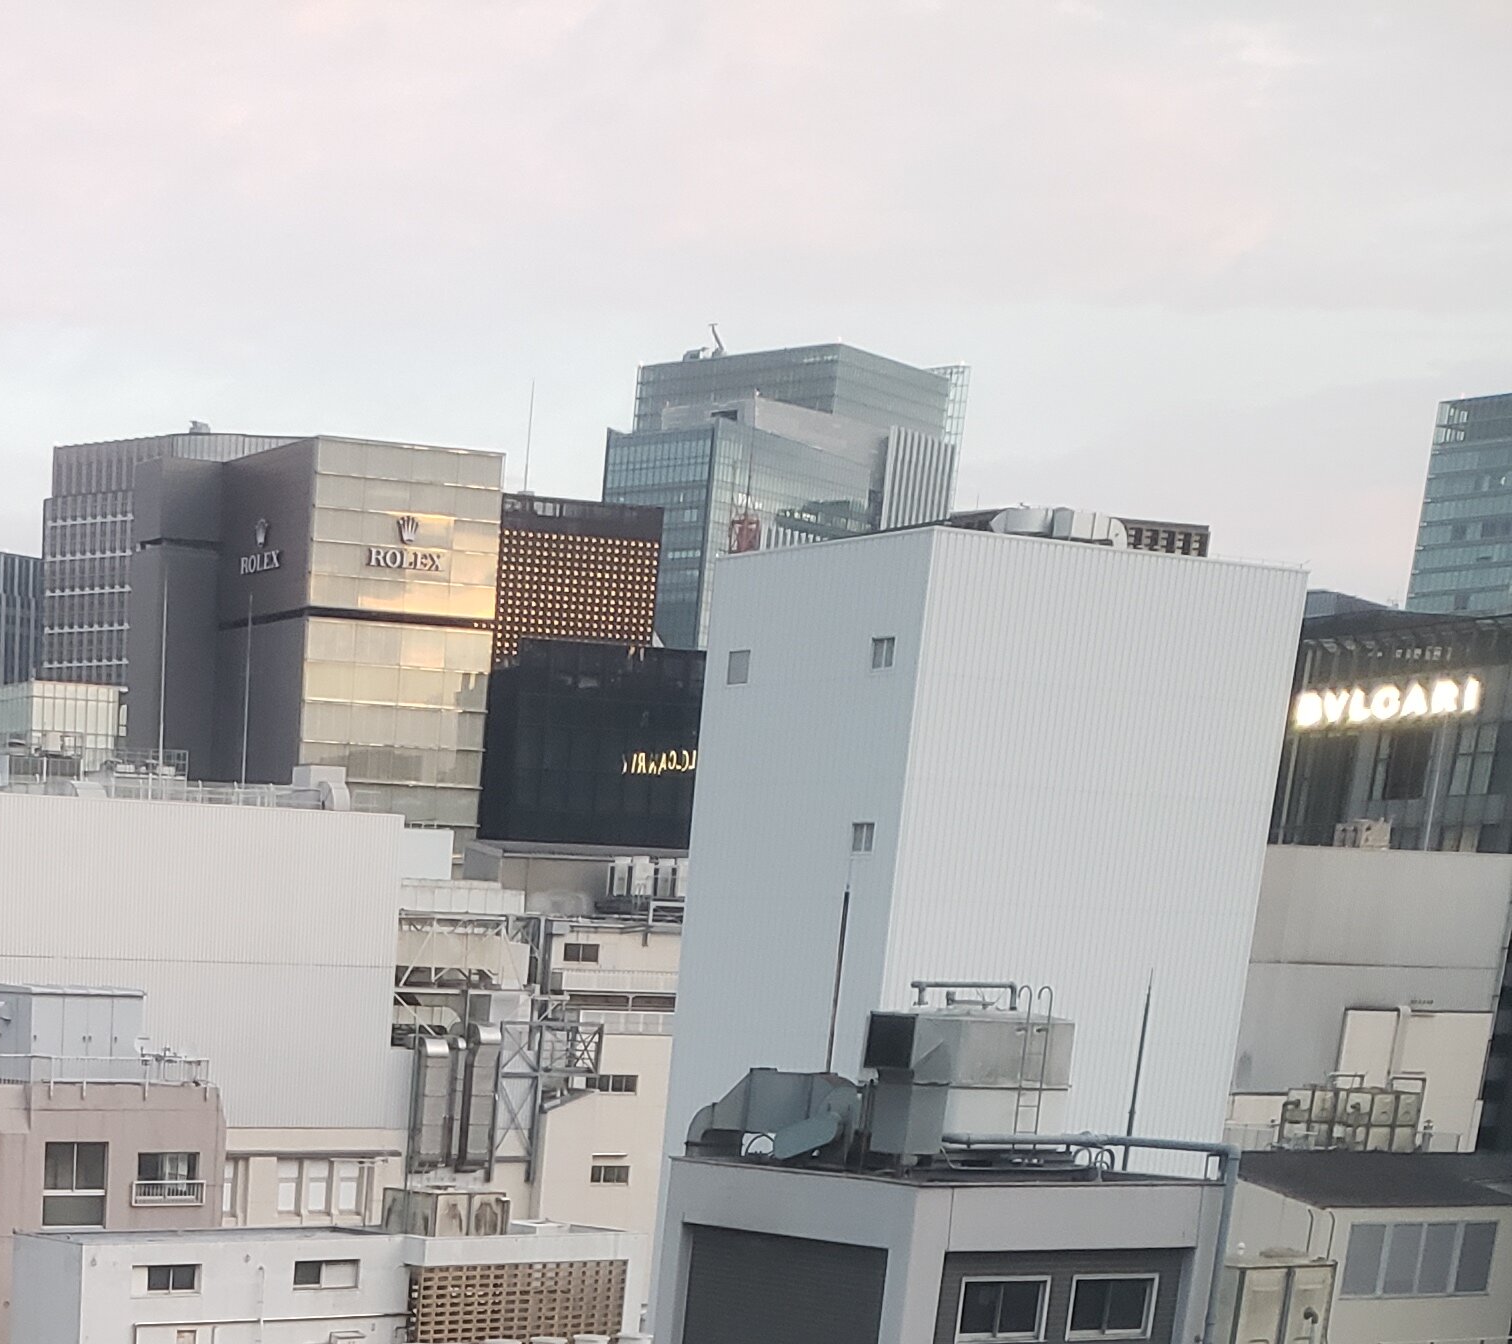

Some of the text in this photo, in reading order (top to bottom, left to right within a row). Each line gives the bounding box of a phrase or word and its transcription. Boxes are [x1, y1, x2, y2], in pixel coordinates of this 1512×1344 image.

[240, 550, 281, 575] ROLEX
[367, 547, 443, 571] ROLEX
[1295, 676, 1480, 727] BVLGARI
